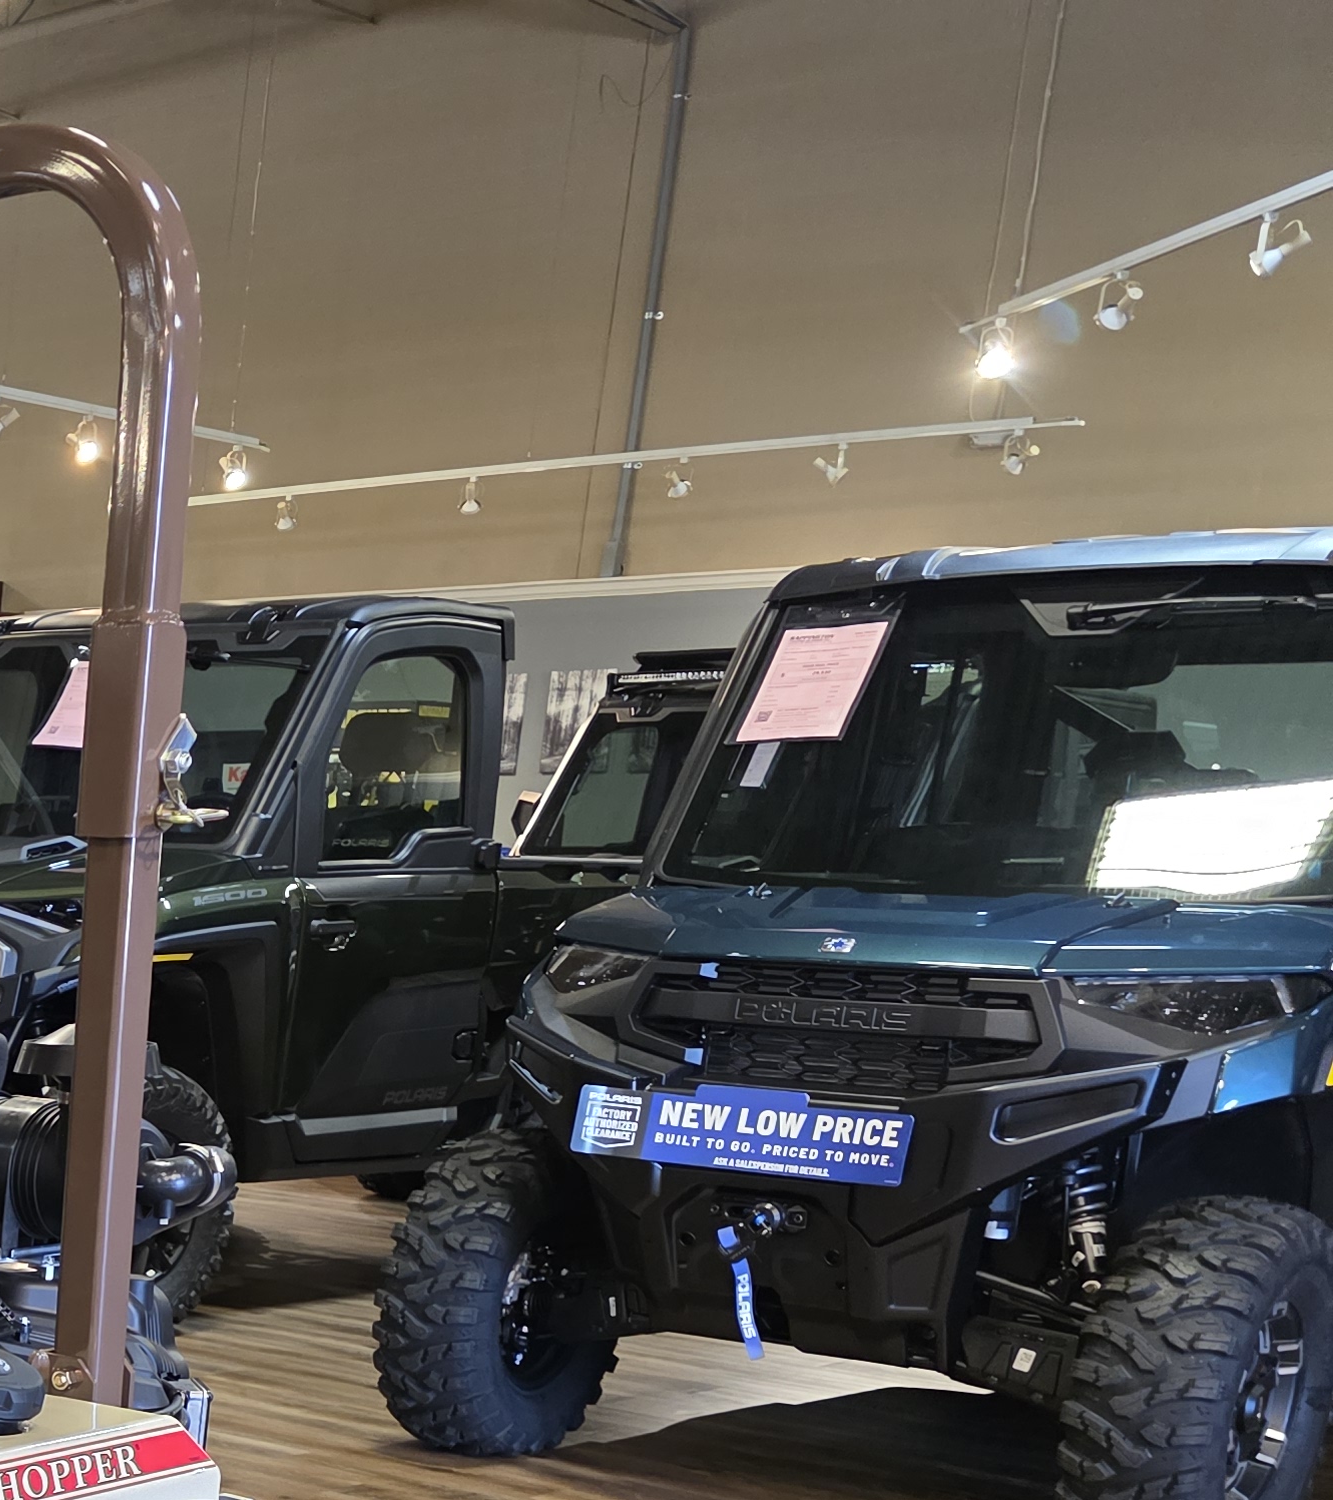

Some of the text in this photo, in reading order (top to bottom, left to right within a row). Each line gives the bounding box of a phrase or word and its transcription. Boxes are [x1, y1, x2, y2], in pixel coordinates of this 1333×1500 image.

[192, 888, 268, 907] 1500
[735, 998, 912, 1032] POLARIS
[588, 1091, 642, 1105] POLARIS
[592, 1107, 632, 1120] FACTORY
[583, 1116, 638, 1131] AUTHORIZED
[659, 1099, 903, 1148] NEW LOW PRICE
[585, 1126, 632, 1140] CLEARANCE
[654, 1131, 894, 1168] BUILT TO GO. PRICED TO MOVE.
[735, 1158, 785, 1172] SALESPERSON
[737, 1273, 757, 1339] POLARIS
